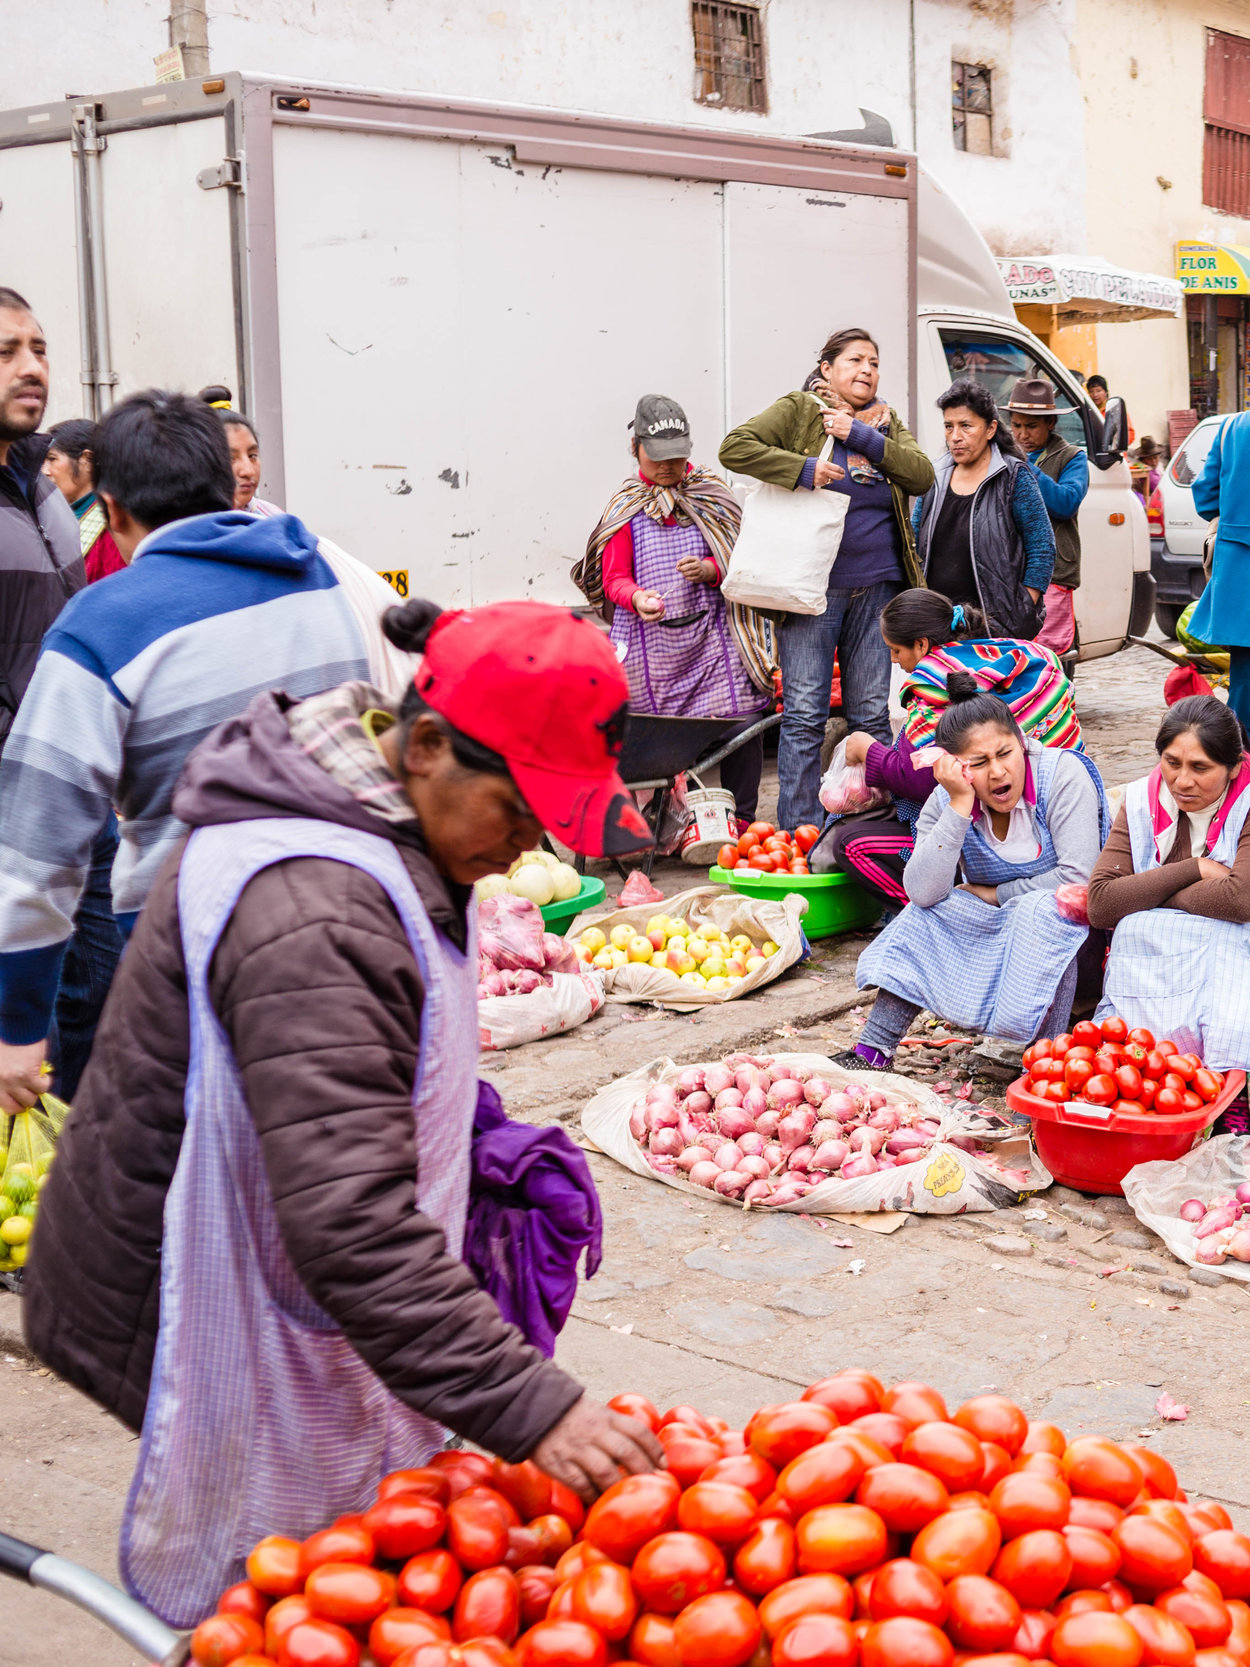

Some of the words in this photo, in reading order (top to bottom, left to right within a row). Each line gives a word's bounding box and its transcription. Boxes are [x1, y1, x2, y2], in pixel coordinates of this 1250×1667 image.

[1180, 257, 1217, 270] FLOR
[1180, 277, 1199, 289] DE
[1202, 277, 1238, 289] ANIS
[1100, 273, 1177, 309] PELADO
[648, 418, 685, 436] CANADA
